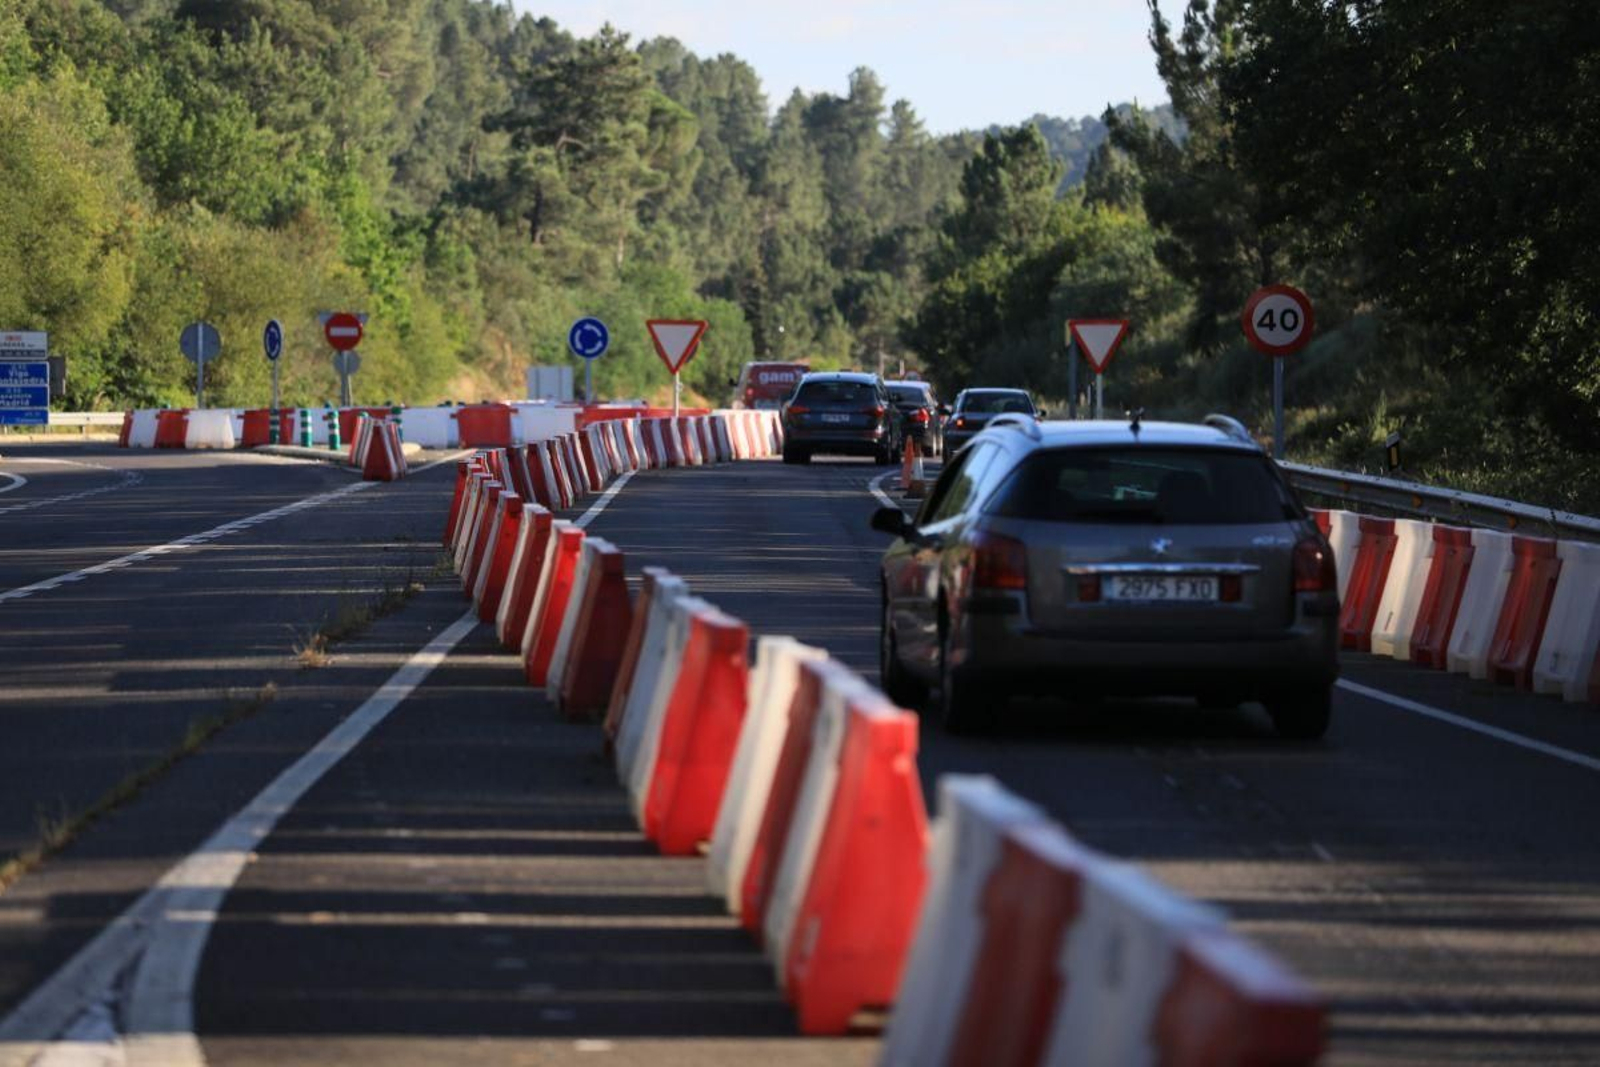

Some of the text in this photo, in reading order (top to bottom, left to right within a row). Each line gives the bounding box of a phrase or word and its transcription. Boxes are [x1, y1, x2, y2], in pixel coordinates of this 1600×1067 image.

[1257, 308, 1299, 332] 40
[759, 372, 794, 385] gam
[1119, 579, 1168, 599] 2975
